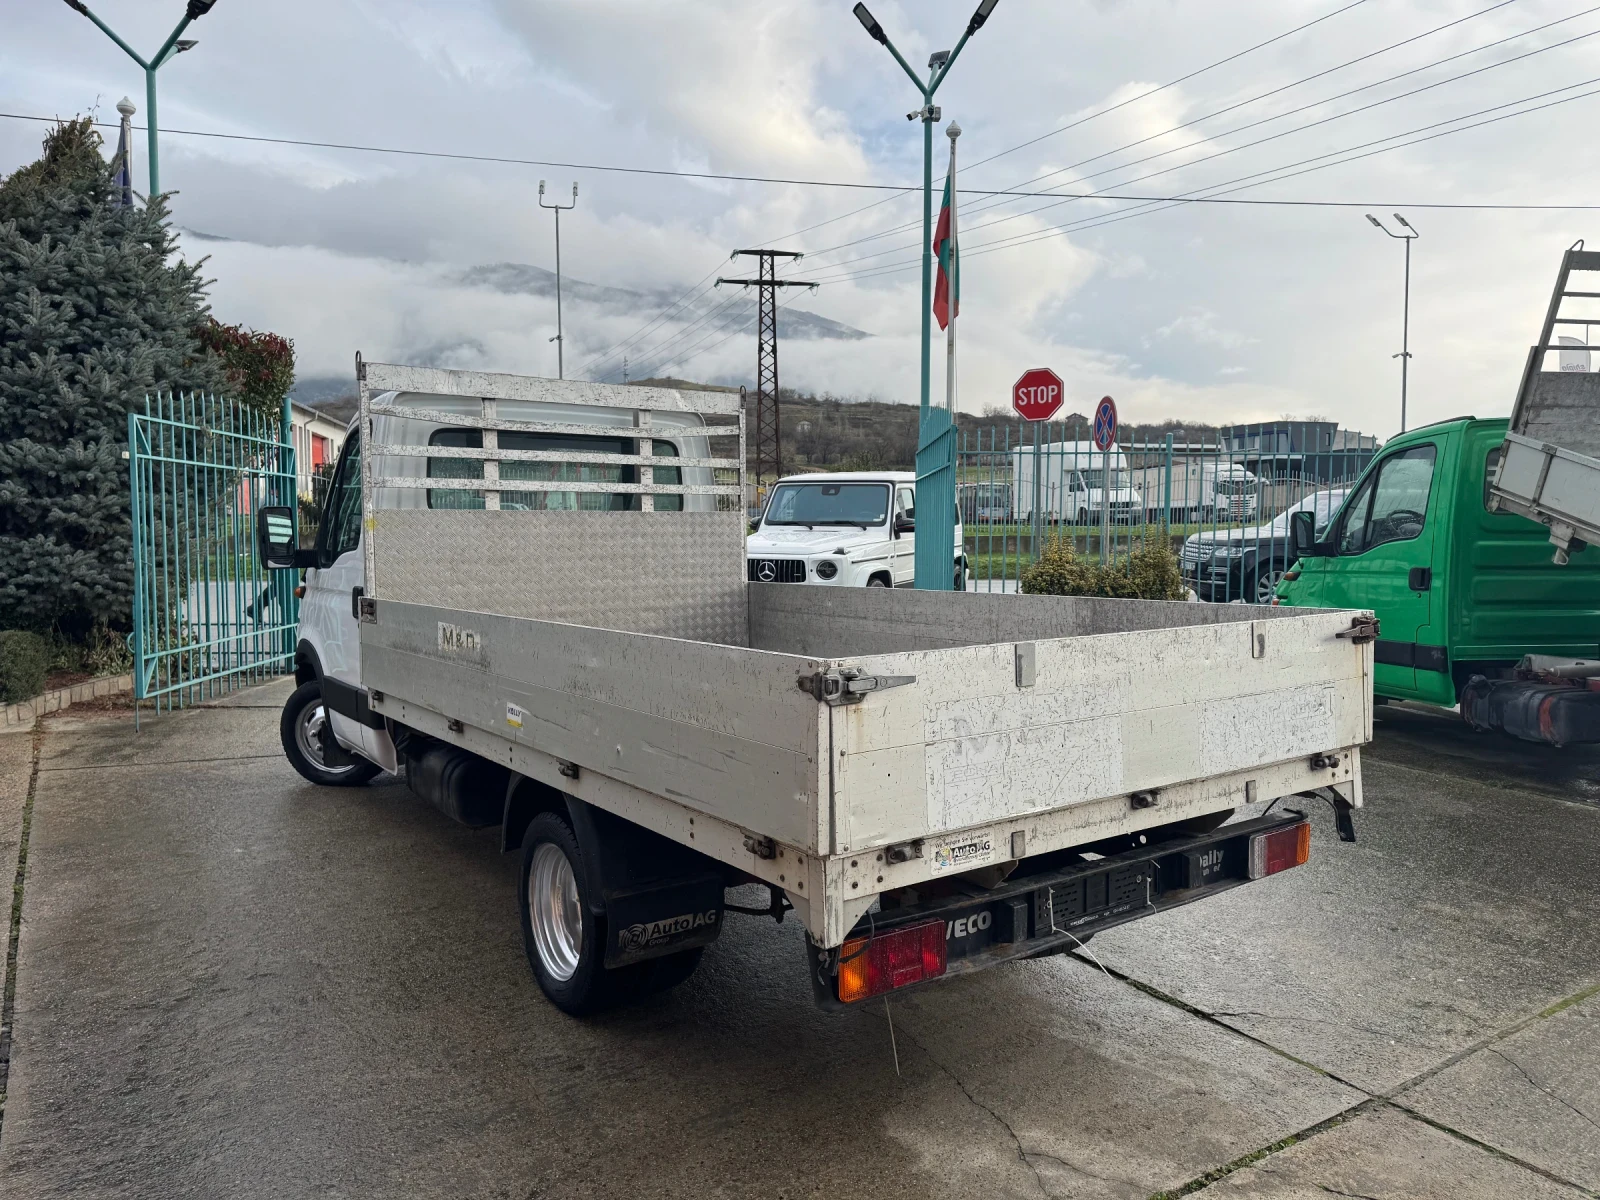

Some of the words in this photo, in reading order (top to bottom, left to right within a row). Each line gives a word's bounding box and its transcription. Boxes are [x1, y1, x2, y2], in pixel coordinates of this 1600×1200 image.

[1018, 385, 1058, 406] STOP
[650, 919, 690, 938] Auto
[692, 909, 716, 928] AG
